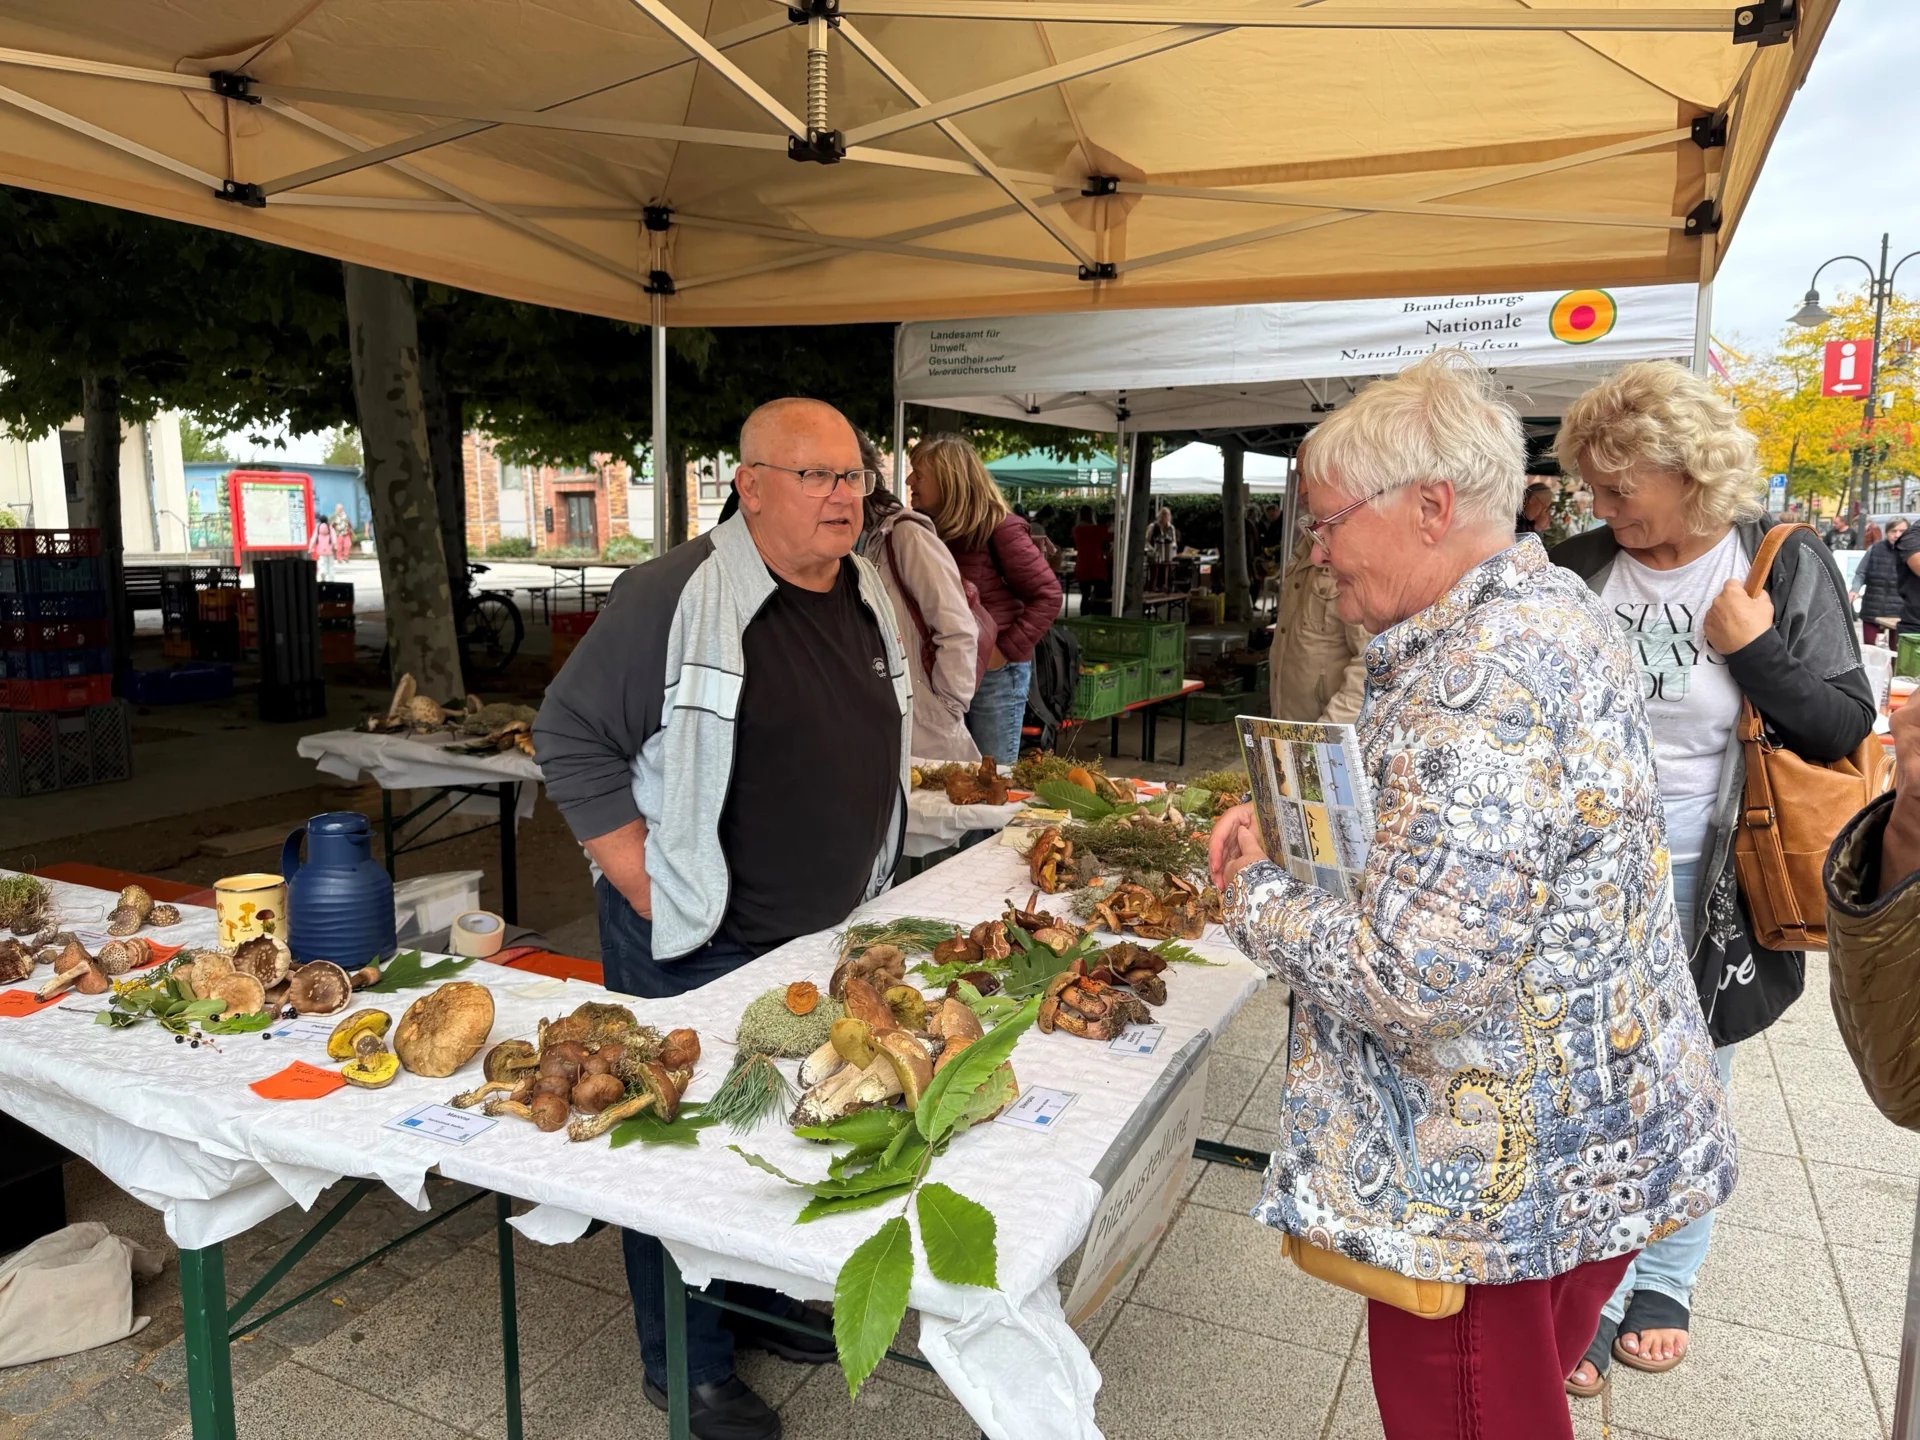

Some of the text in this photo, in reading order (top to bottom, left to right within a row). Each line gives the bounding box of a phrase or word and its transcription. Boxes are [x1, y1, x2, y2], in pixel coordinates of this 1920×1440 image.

[1402, 294, 1524, 313] Brandenburgs
[1425, 313, 1522, 335] Nationale
[930, 329, 1001, 339] Landesamt für
[930, 343, 967, 352] Umwelt,
[1340, 339, 1519, 361] Naturlandhaften
[929, 356, 984, 365] Gesundheit
[929, 365, 1016, 376] Verbraucherschutz
[1614, 602, 1705, 634] STAY
